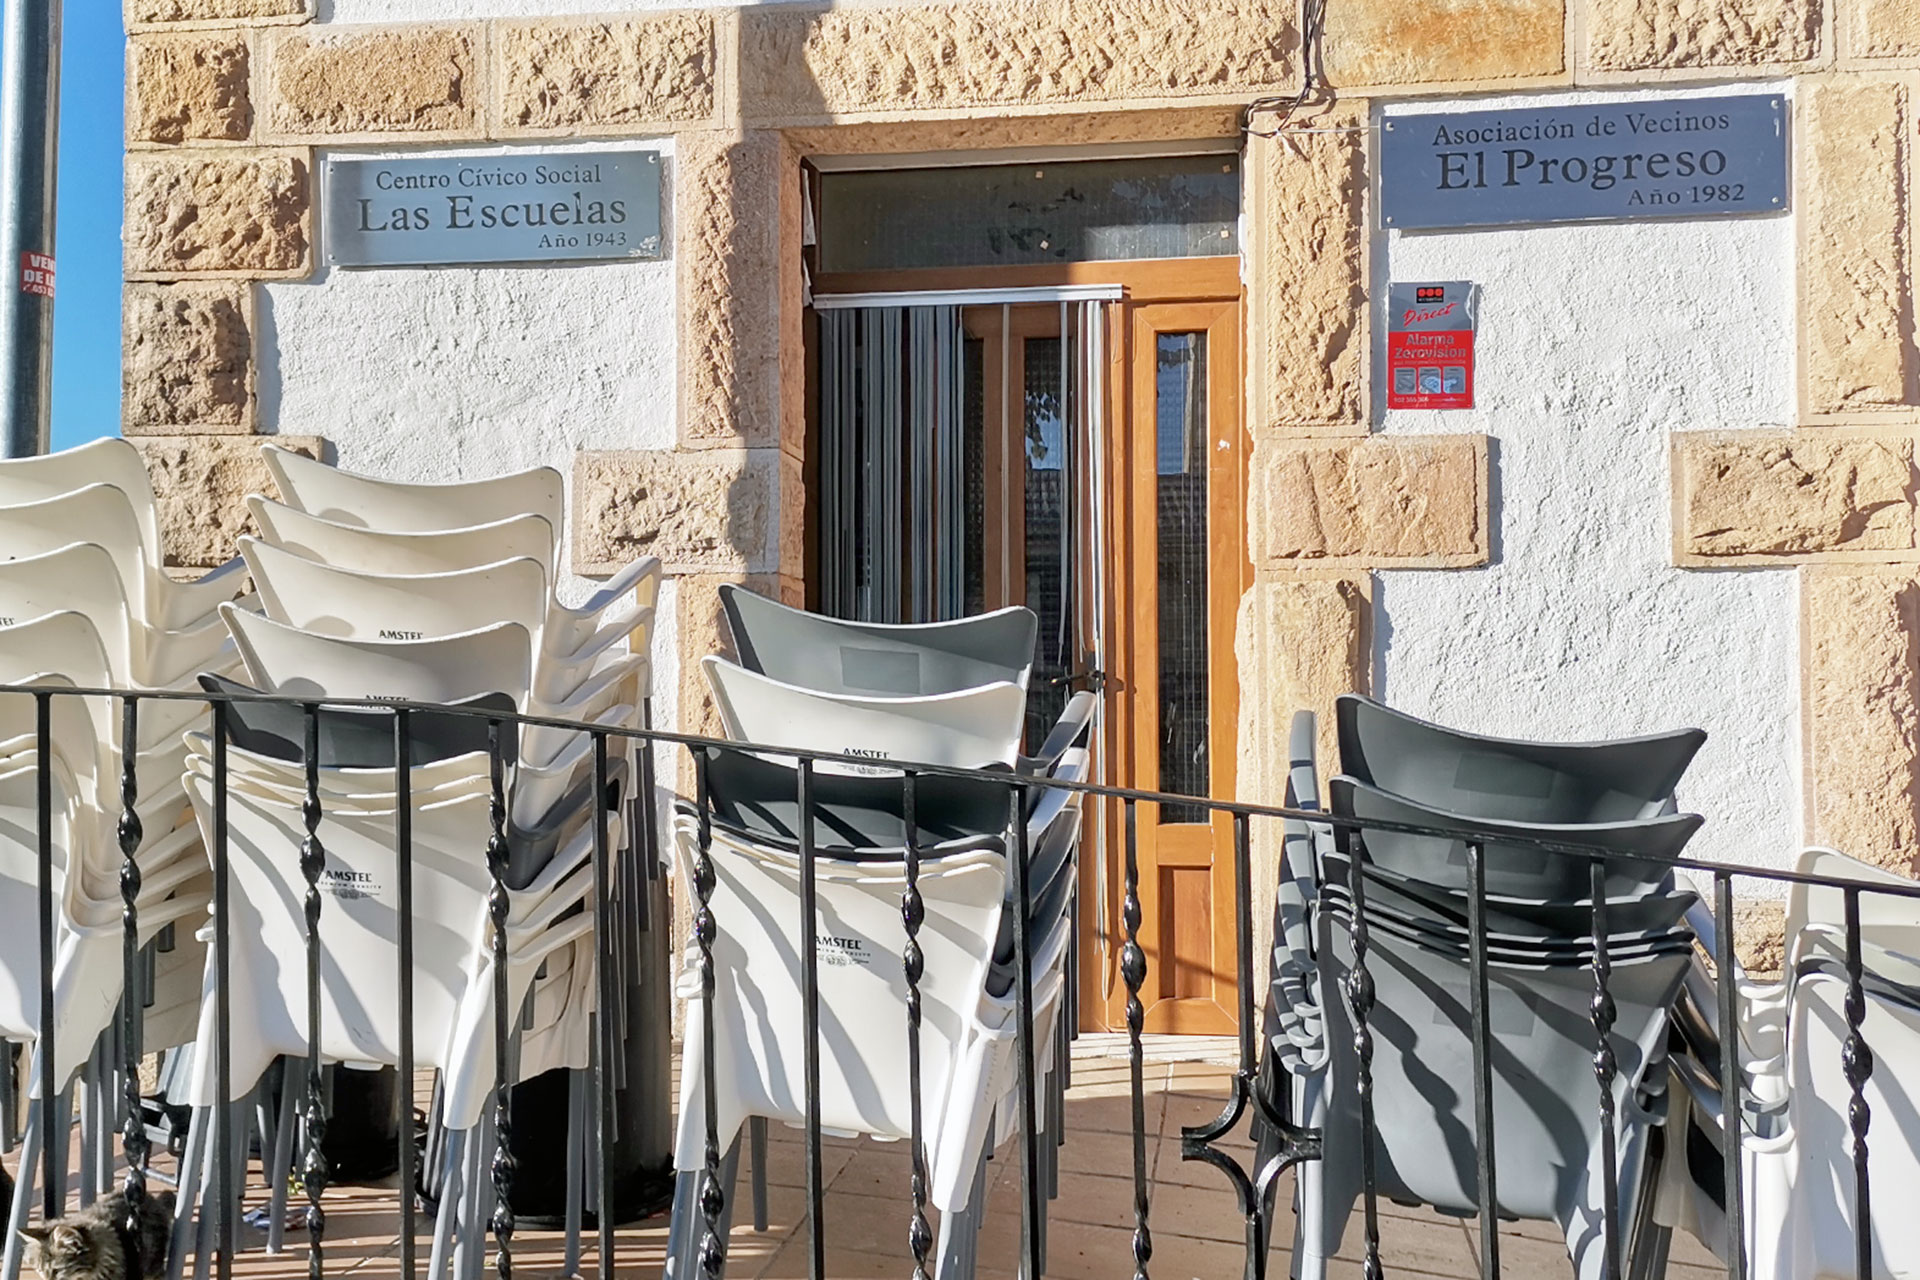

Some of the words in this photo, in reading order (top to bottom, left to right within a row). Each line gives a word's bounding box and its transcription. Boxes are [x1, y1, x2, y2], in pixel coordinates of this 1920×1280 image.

[1432, 117, 1574, 146] Asociación
[1586, 116, 1616, 137] de
[1624, 110, 1730, 135] Vecinos
[376, 170, 450, 190] Centro
[458, 168, 527, 187] Cívico
[535, 164, 602, 185] Social
[1436, 150, 1487, 190] El
[1502, 147, 1727, 190] Progreso
[1627, 188, 1681, 206] Año
[1691, 184, 1745, 202] 1982
[357, 198, 430, 232] Las
[446, 191, 627, 229] Escuelas
[538, 233, 578, 249] Año
[586, 232, 627, 247] 1943
[24, 269, 44, 284] DE
[1402, 302, 1460, 327] Direct
[1406, 334, 1454, 345] Alarma
[1394, 345, 1466, 359] Zerovision
[326, 870, 372, 883] AMSTEL
